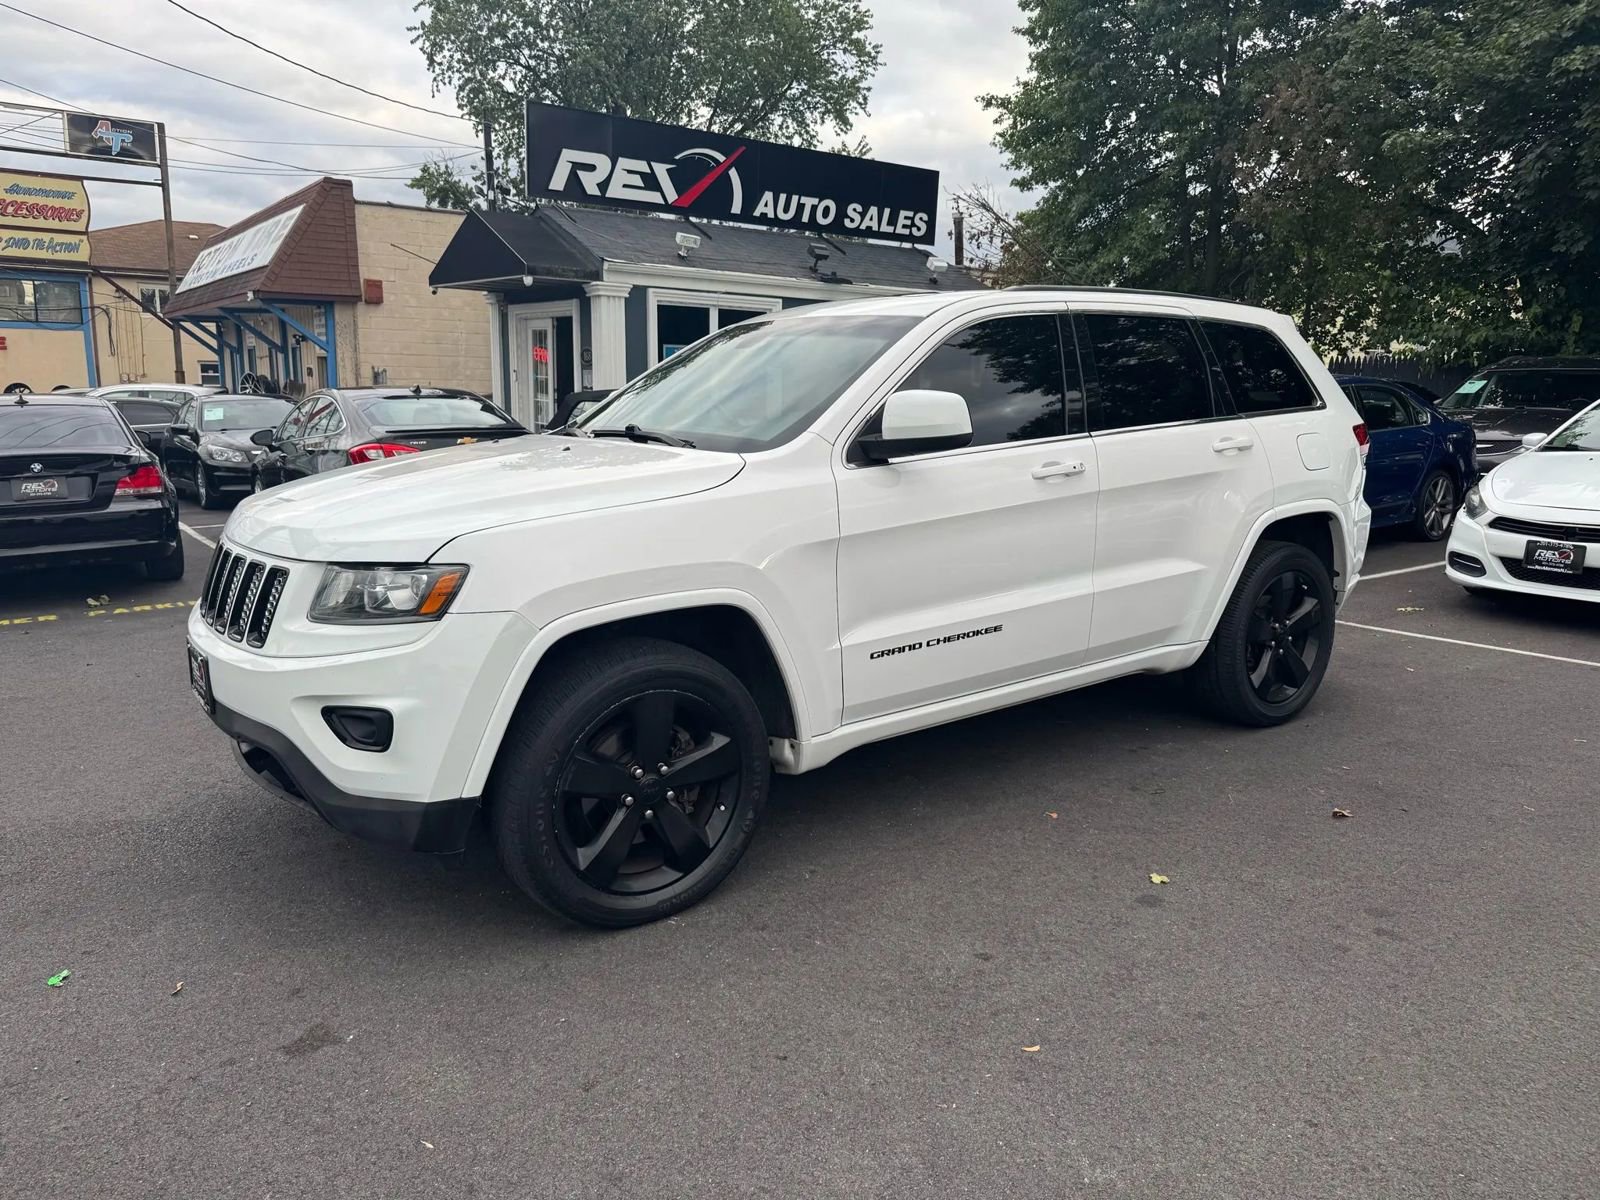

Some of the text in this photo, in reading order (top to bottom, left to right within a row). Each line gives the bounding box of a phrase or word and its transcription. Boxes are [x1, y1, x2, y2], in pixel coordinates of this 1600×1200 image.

[548, 146, 746, 214] REV
[753, 190, 928, 237] AUTO SALES
[870, 624, 1003, 660] GRAND CHEROKEE
